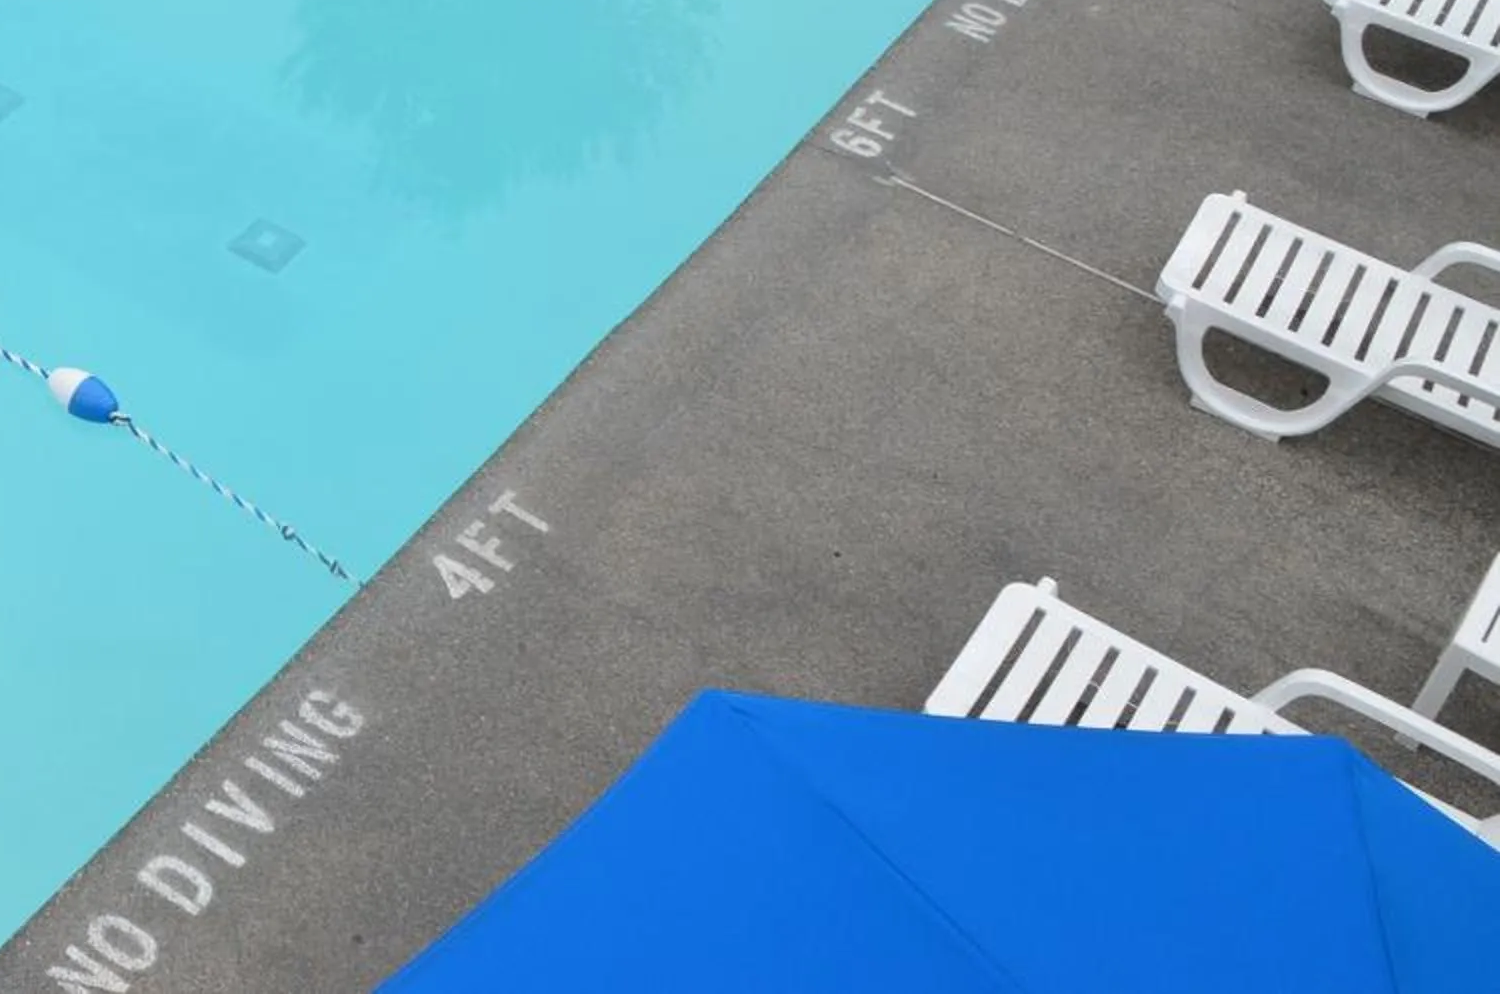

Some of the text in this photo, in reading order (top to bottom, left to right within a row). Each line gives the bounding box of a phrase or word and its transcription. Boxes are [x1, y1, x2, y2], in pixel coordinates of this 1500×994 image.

[946, 2, 1007, 43] NO
[830, 89, 918, 158] 6FT
[432, 489, 550, 600] 4FT
[46, 689, 364, 994] NO DIVING
